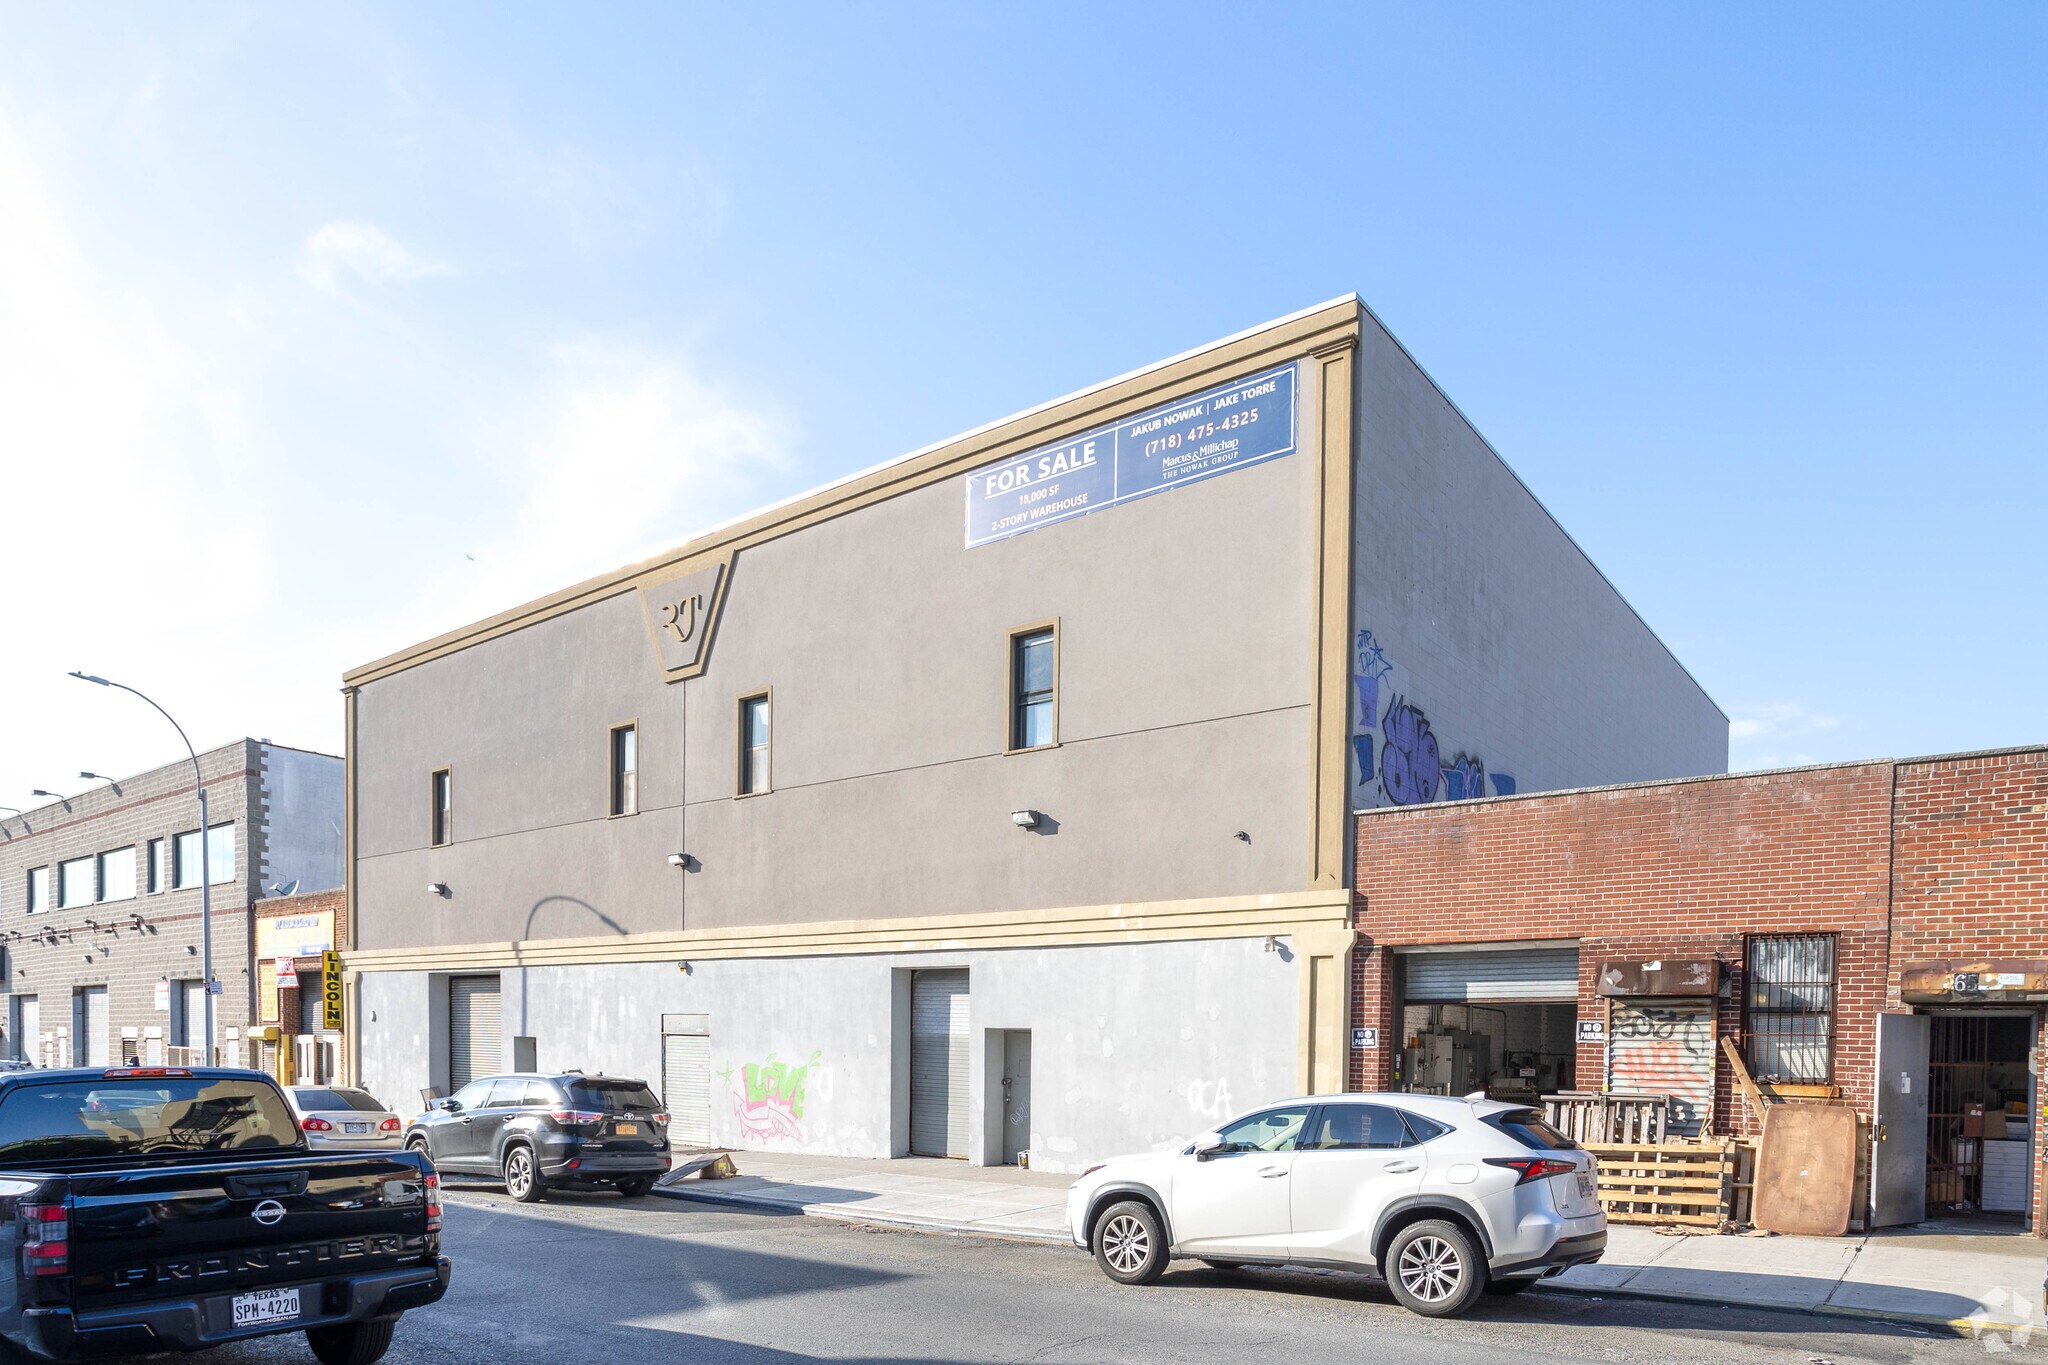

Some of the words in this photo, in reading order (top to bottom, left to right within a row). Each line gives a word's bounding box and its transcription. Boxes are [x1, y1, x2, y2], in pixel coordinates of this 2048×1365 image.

[1130, 418, 1162, 438] JAKUB
[1163, 404, 1203, 427] NOWAK
[1213, 393, 1239, 411] JAKE
[1241, 381, 1276, 401] TORRE
[1145, 432, 1182, 458] (718)
[1187, 407, 1259, 441] 475-4325
[986, 464, 1031, 496] FOR
[1037, 441, 1096, 479] SALE
[1162, 469, 1178, 480] THE
[1180, 458, 1209, 475] NOWAK
[1211, 451, 1239, 465] GROUP
[1018, 488, 1047, 506] 18,000
[1048, 484, 1060, 496] SF
[991, 512, 1029, 531] 2-STORY
[1029, 493, 1089, 519] WAREHOUSE
[326, 953, 340, 1020] LINCOLN
[1354, 1038, 1375, 1046] PARKING
[1580, 1032, 1605, 1040] PARKING
[1583, 1023, 1592, 1032] NO
[251, 1208, 287, 1217] NISSAN
[114, 1238, 399, 1287] FRONTIER
[253, 1290, 280, 1301] TEXAS
